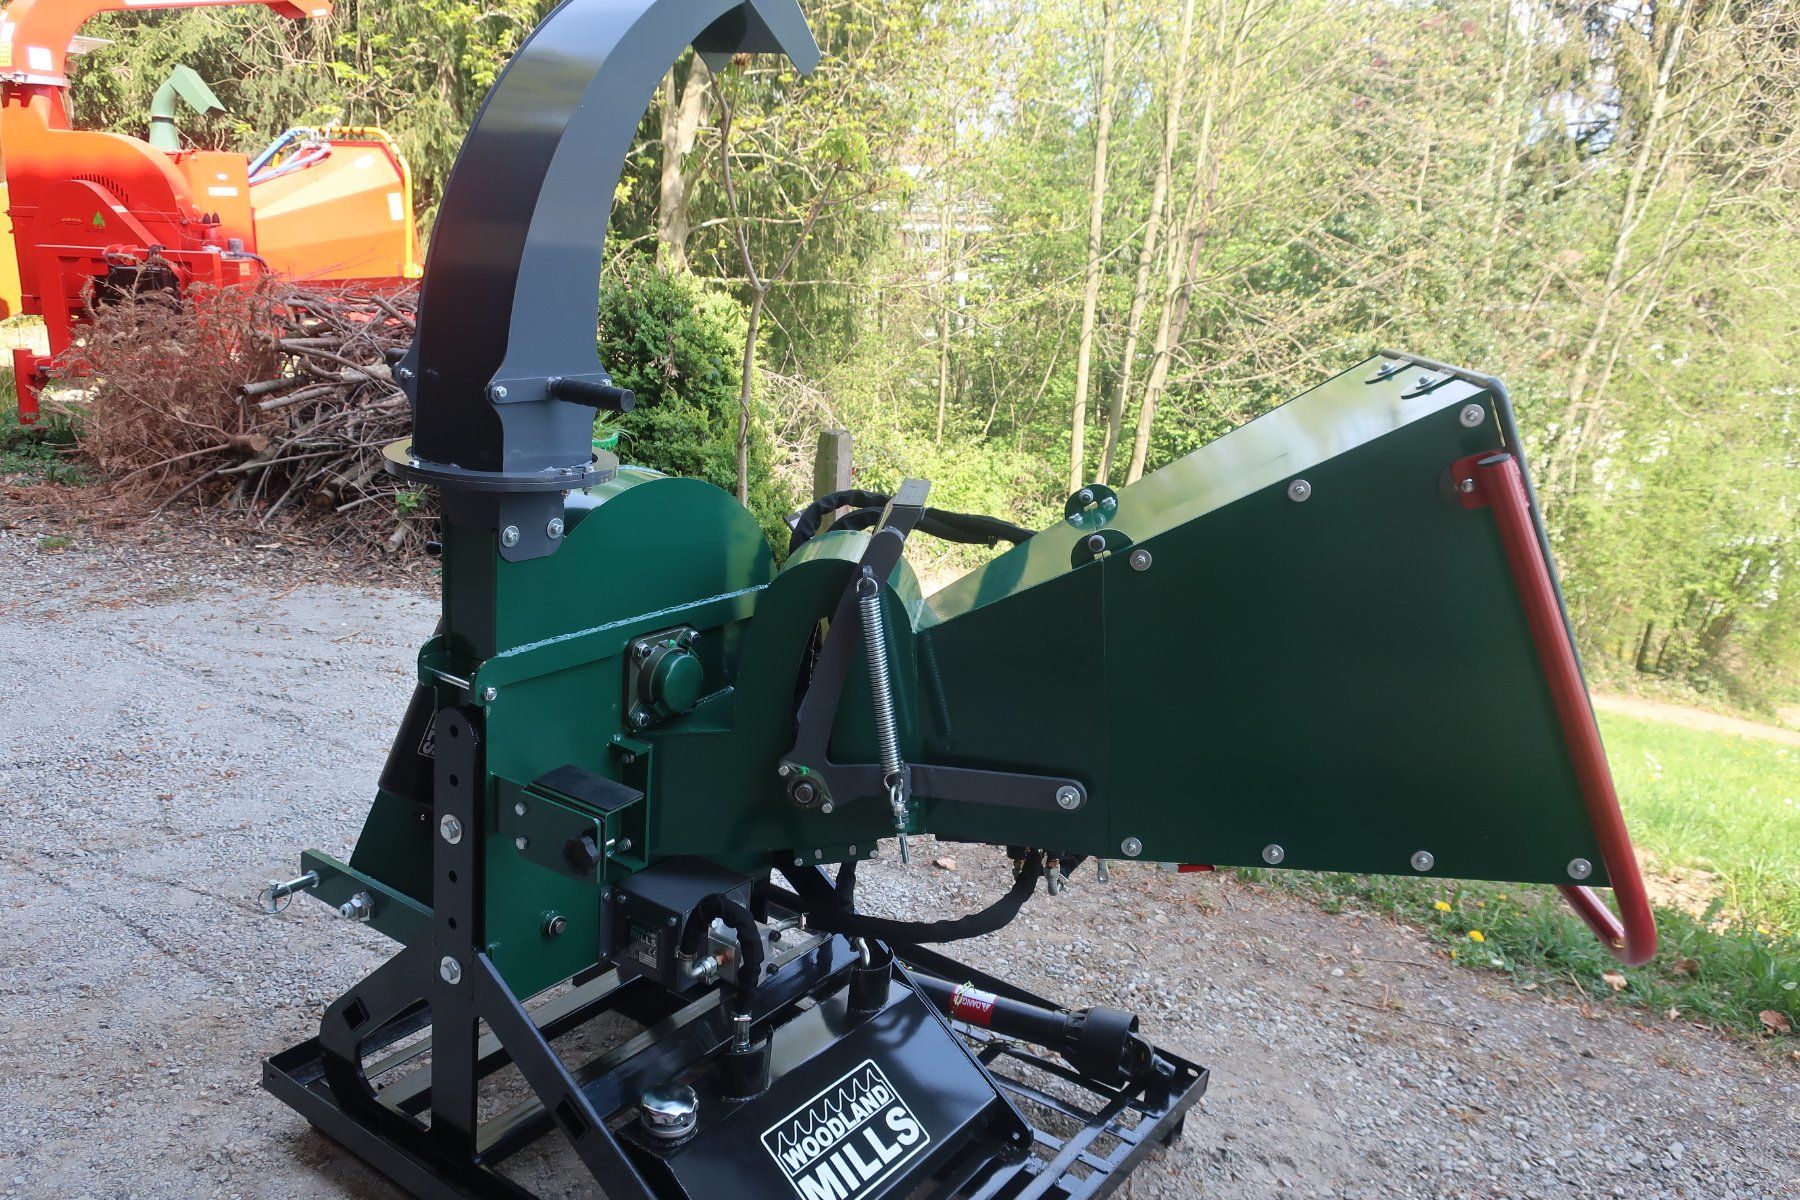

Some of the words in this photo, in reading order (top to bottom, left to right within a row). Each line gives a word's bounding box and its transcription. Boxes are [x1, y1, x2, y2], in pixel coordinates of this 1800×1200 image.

[954, 994, 981, 1009] DANG
[782, 1084, 890, 1171] WOODLAND
[797, 1106, 920, 1200] MILLS
